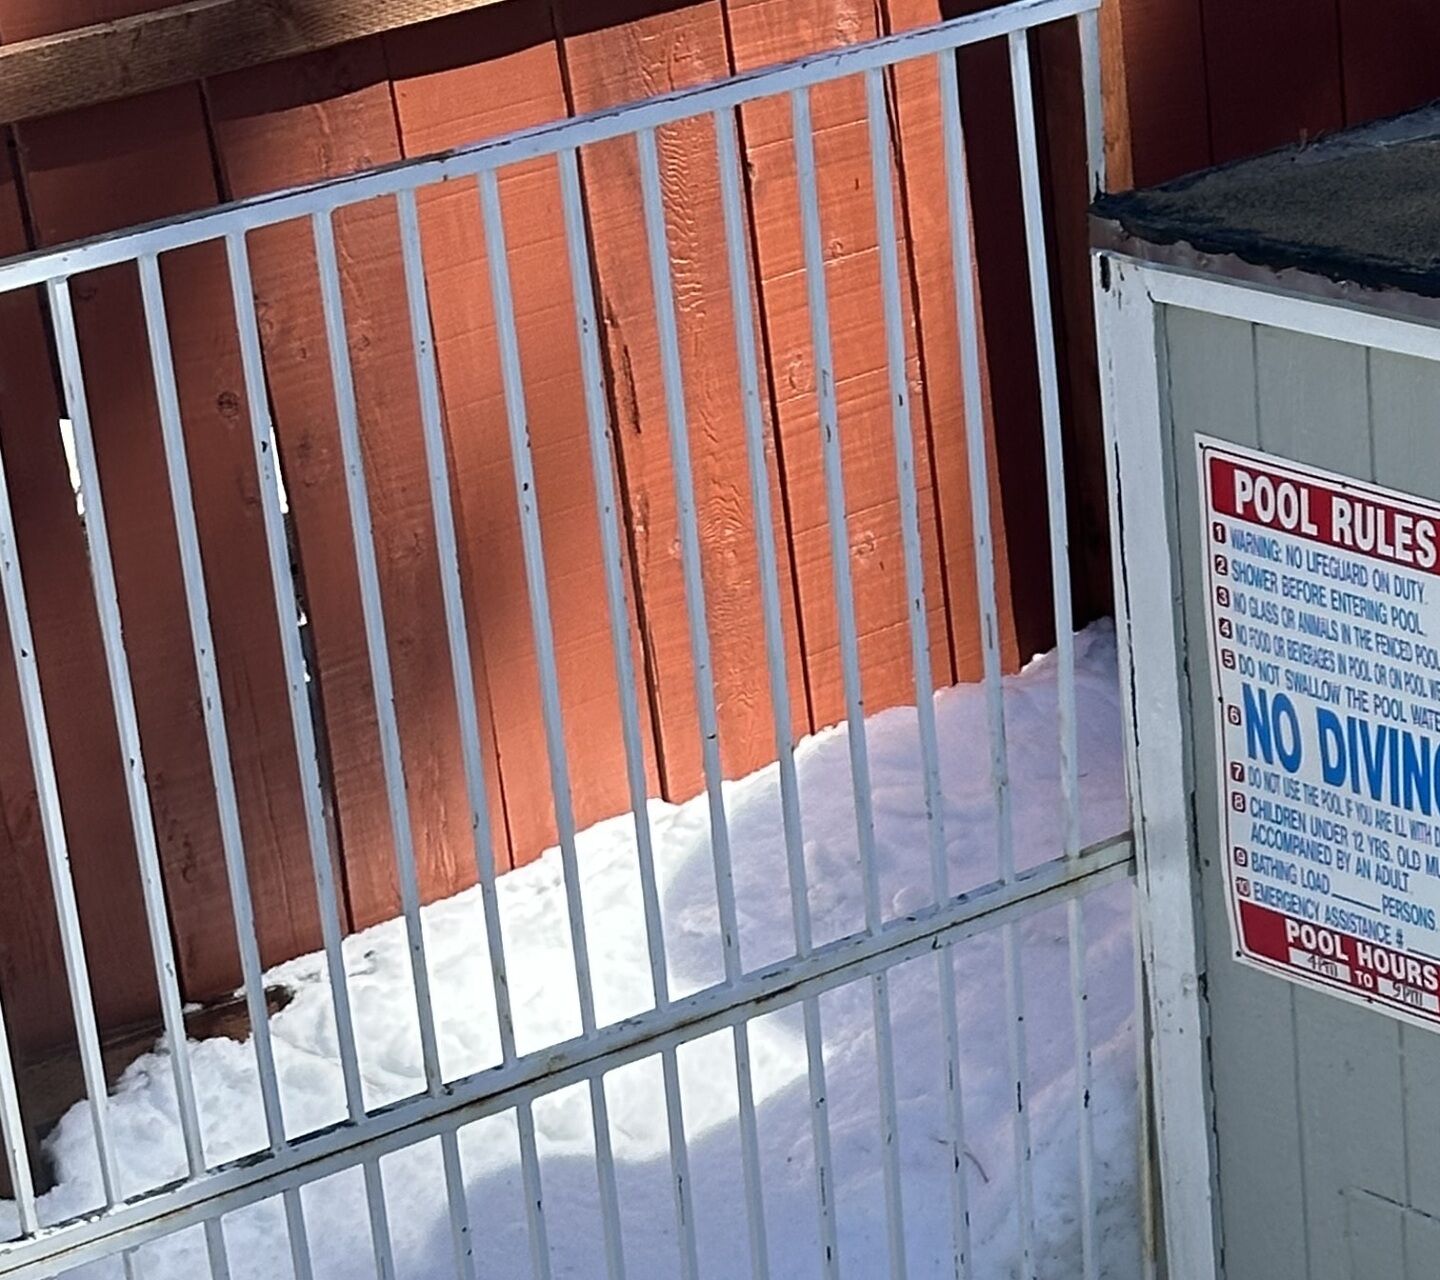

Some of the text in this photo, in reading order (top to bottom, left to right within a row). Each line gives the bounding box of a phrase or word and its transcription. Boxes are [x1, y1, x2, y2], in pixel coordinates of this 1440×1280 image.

[1233, 469, 1437, 568] POOL RULES
[1231, 558, 1279, 594] SHOWER
[1281, 574, 1328, 608] BEFORE
[1330, 588, 1388, 626] ENTERING
[1285, 544, 1303, 570] NO
[1305, 549, 1369, 588] LIFEGUARD
[1372, 568, 1391, 595] ON
[1241, 682, 1302, 774] NO
[1249, 796, 1307, 834] CHILDREN
[1309, 815, 1349, 847] UNDER
[1351, 830, 1365, 853] 12
[1366, 835, 1394, 863] YRS.
[1396, 845, 1421, 872] OLD
[1250, 821, 1333, 866] ACCOMPANIED
[1336, 848, 1351, 873] BY
[1355, 856, 1372, 881] AN
[1285, 918, 1439, 991] POOL HOURS
[1354, 970, 1374, 988] TO
